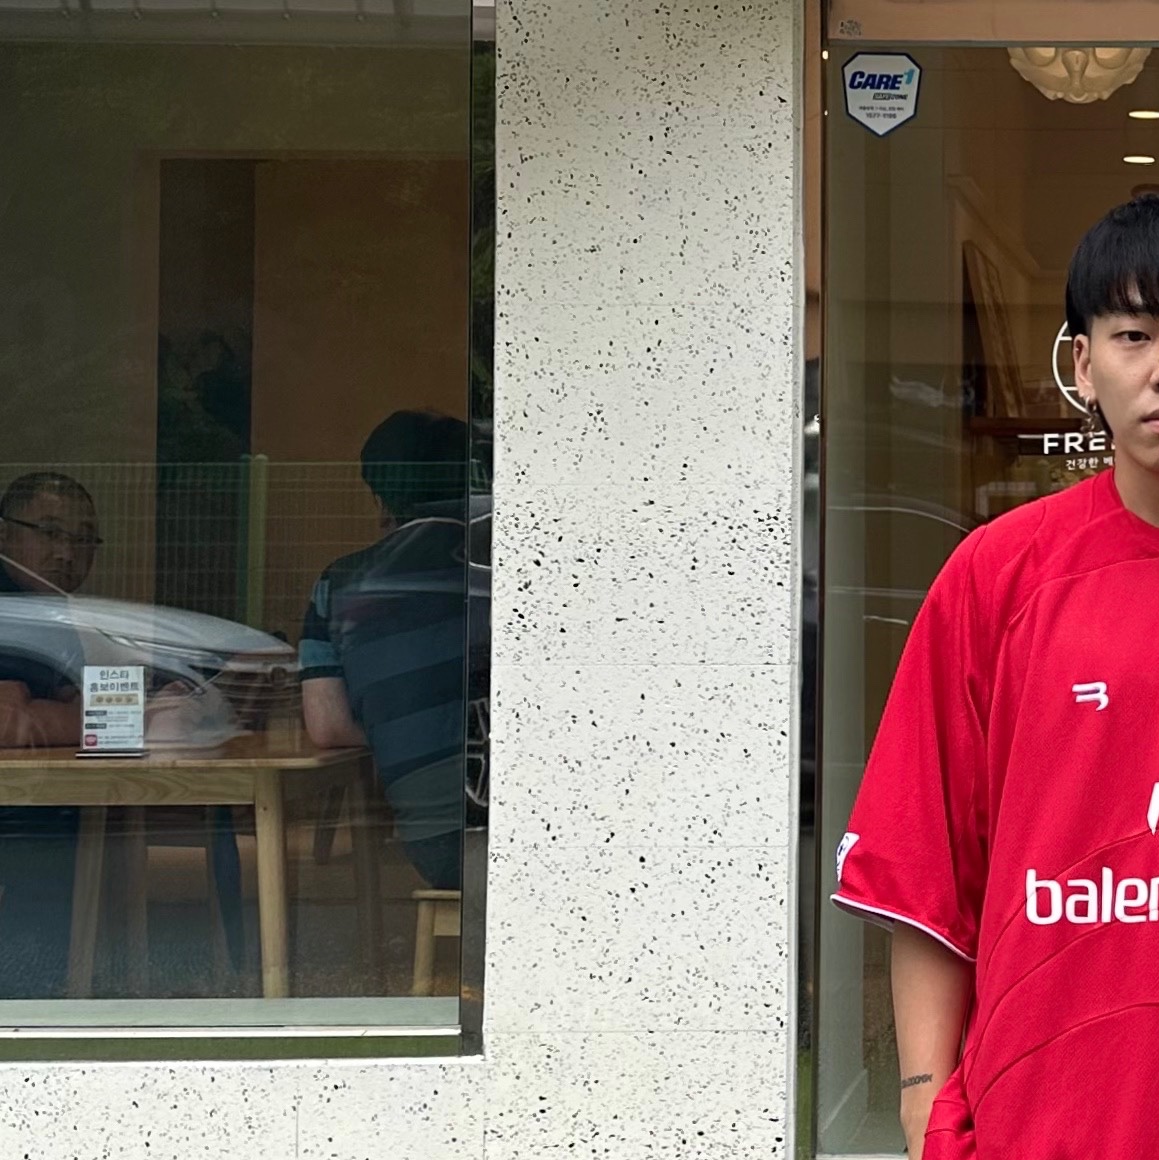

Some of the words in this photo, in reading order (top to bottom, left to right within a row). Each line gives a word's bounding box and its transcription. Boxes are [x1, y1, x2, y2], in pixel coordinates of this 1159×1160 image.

[1043, 431, 1116, 455] FRE
[1066, 457, 1099, 471] 건강한
[99, 669, 129, 681] 인스타
